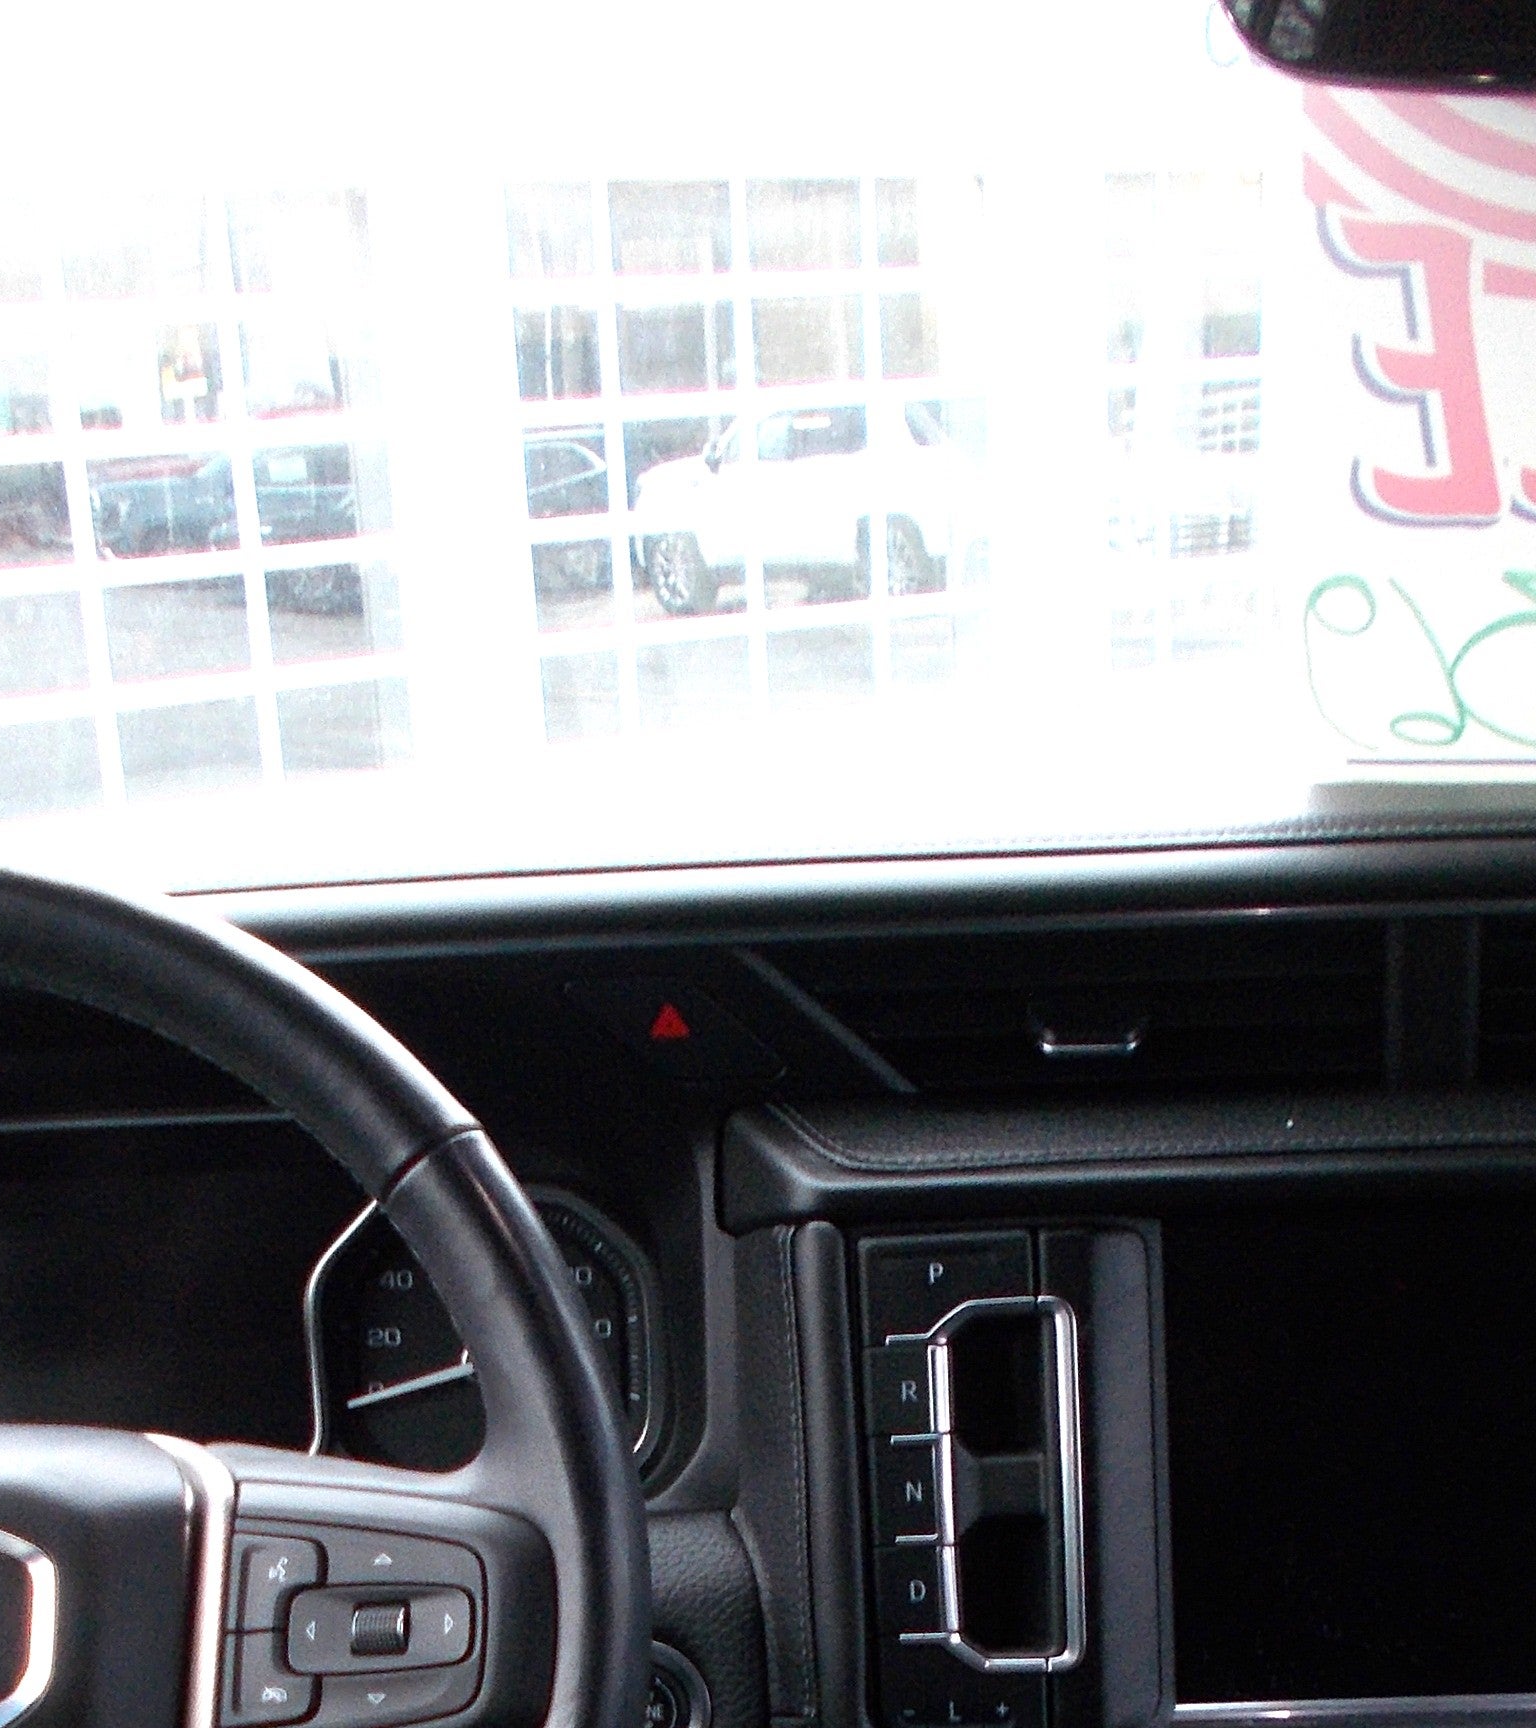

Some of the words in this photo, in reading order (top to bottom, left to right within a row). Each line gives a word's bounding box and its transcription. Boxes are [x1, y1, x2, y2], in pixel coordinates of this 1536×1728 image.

[378, 1268, 414, 1291] 40
[929, 1262, 945, 1286] P
[366, 1326, 402, 1348] 20
[901, 1380, 918, 1401] R
[905, 1481, 923, 1502] N
[909, 1580, 926, 1601] D
